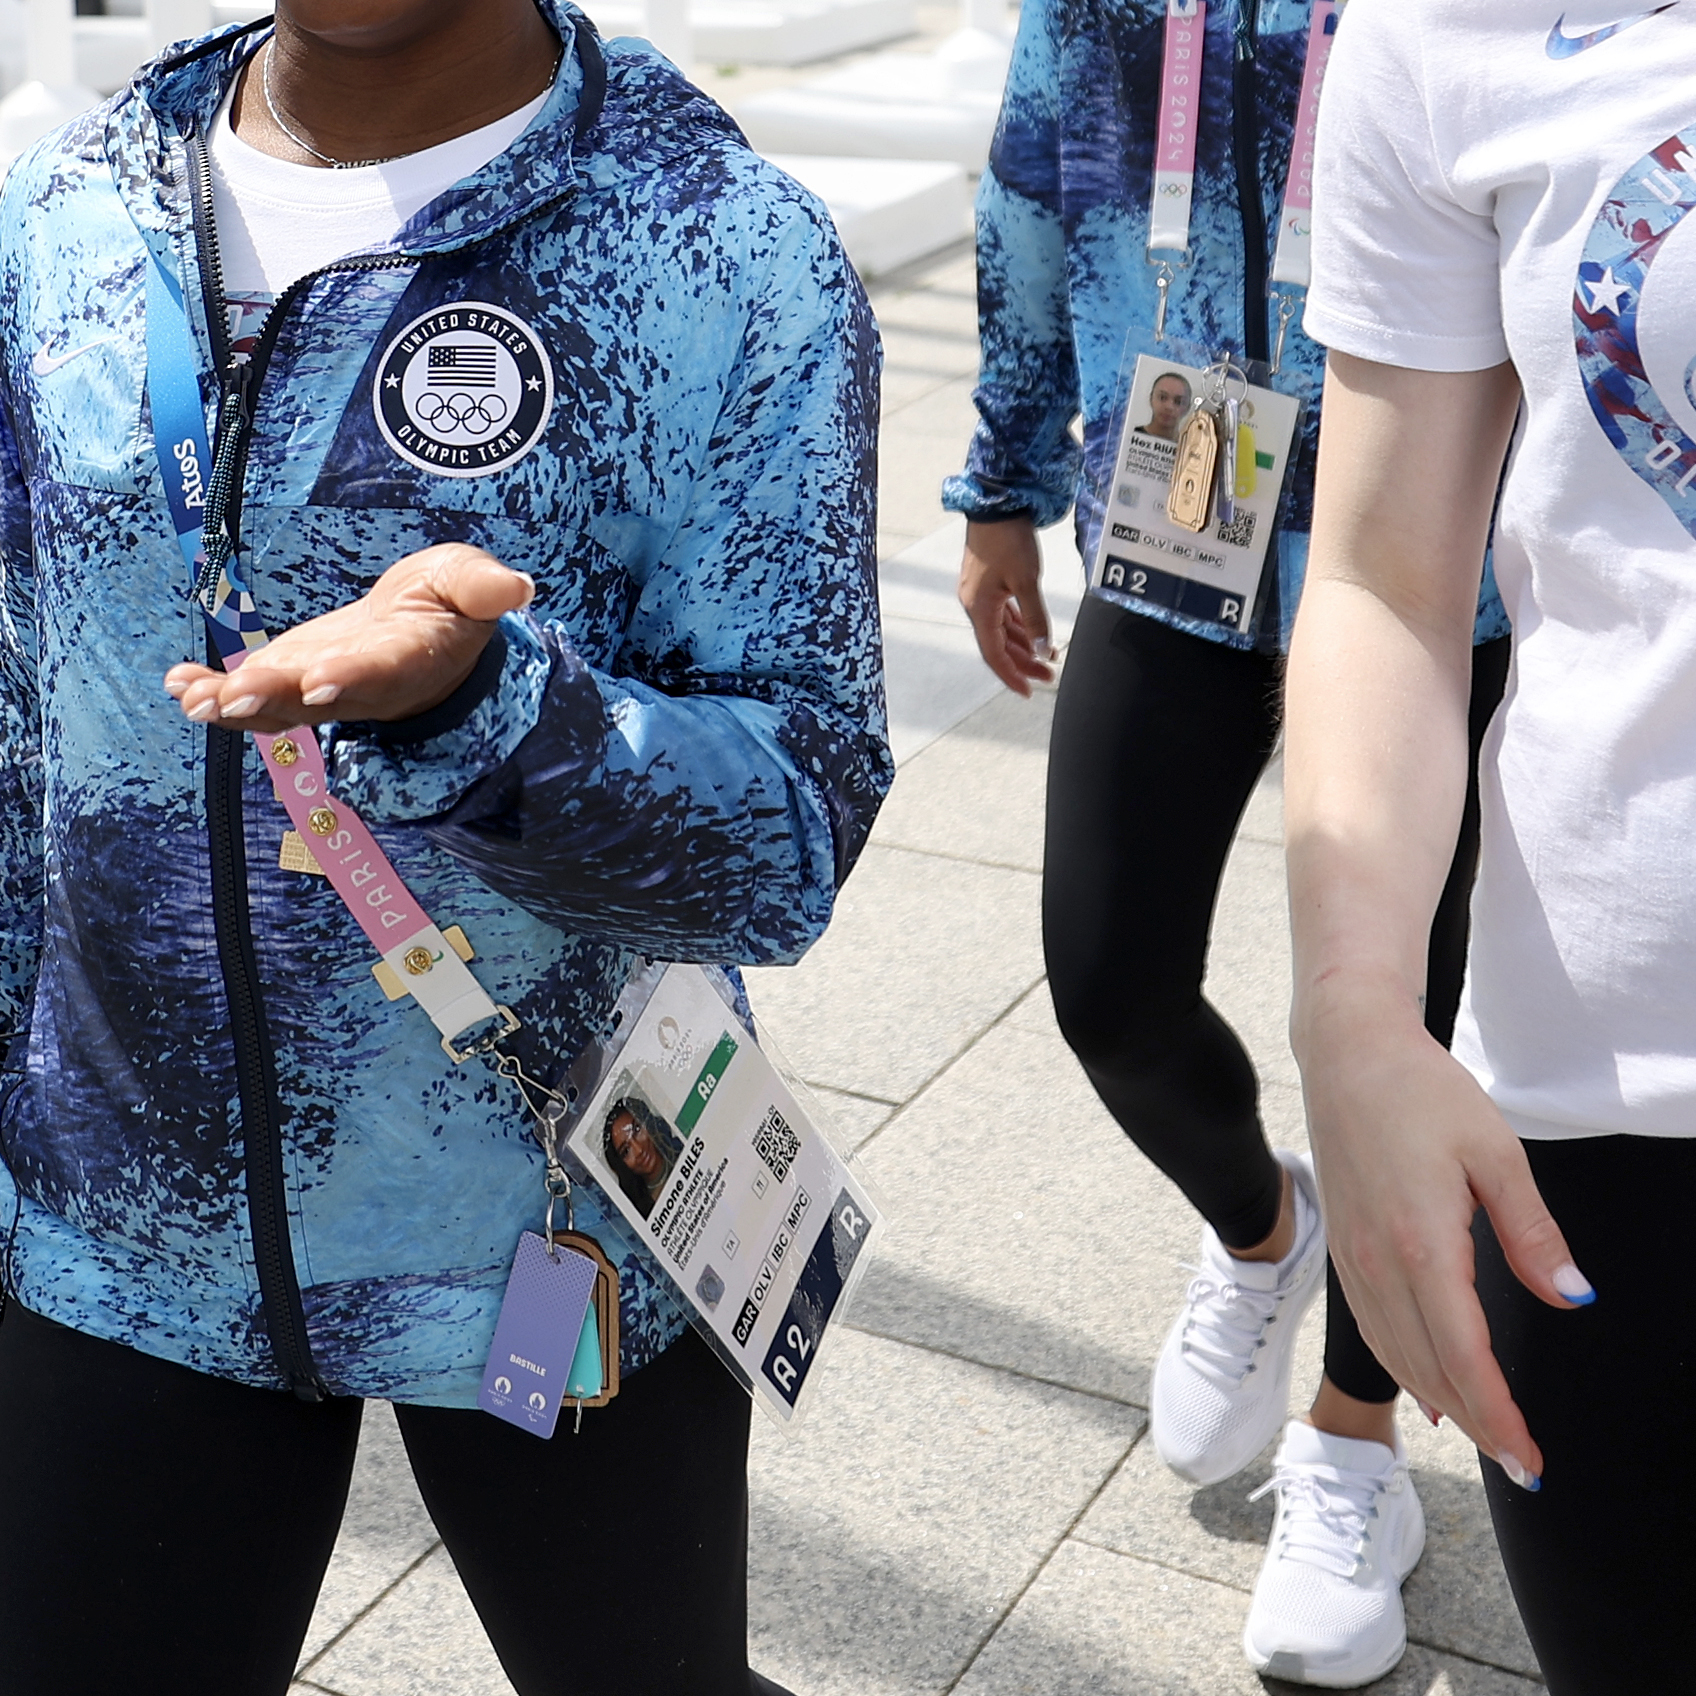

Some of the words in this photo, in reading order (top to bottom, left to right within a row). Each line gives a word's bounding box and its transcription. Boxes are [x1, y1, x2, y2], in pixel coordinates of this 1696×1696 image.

[400, 314, 459, 355] UNITED
[467, 313, 528, 356] STATES
[172, 437, 208, 510] Atos
[397, 424, 470, 465] OLYMPIC
[477, 428, 522, 462] TEAM
[1113, 526, 1139, 541] GAR
[1143, 534, 1167, 548] OLV
[1172, 544, 1193, 557] IBC
[1198, 551, 1225, 568] MPC
[1220, 597, 1240, 624] R
[326, 829, 408, 930] PARIS
[697, 1072, 717, 1101] Aa
[650, 1179, 685, 1238] Simone
[679, 1136, 705, 1180] BILES
[661, 1205, 686, 1249] OLYMPIC
[682, 1168, 705, 1207] ATHLETE
[672, 1233, 691, 1265] United
[688, 1205, 706, 1234] States
[707, 1156, 730, 1195] America
[735, 1304, 758, 1344] GAR
[753, 1271, 774, 1303] OLV
[771, 1232, 790, 1263] IBC
[787, 1193, 809, 1230] MPC
[772, 1355, 798, 1392] A
[838, 1205, 865, 1240] R
[509, 1353, 547, 1377] BASTILLE
